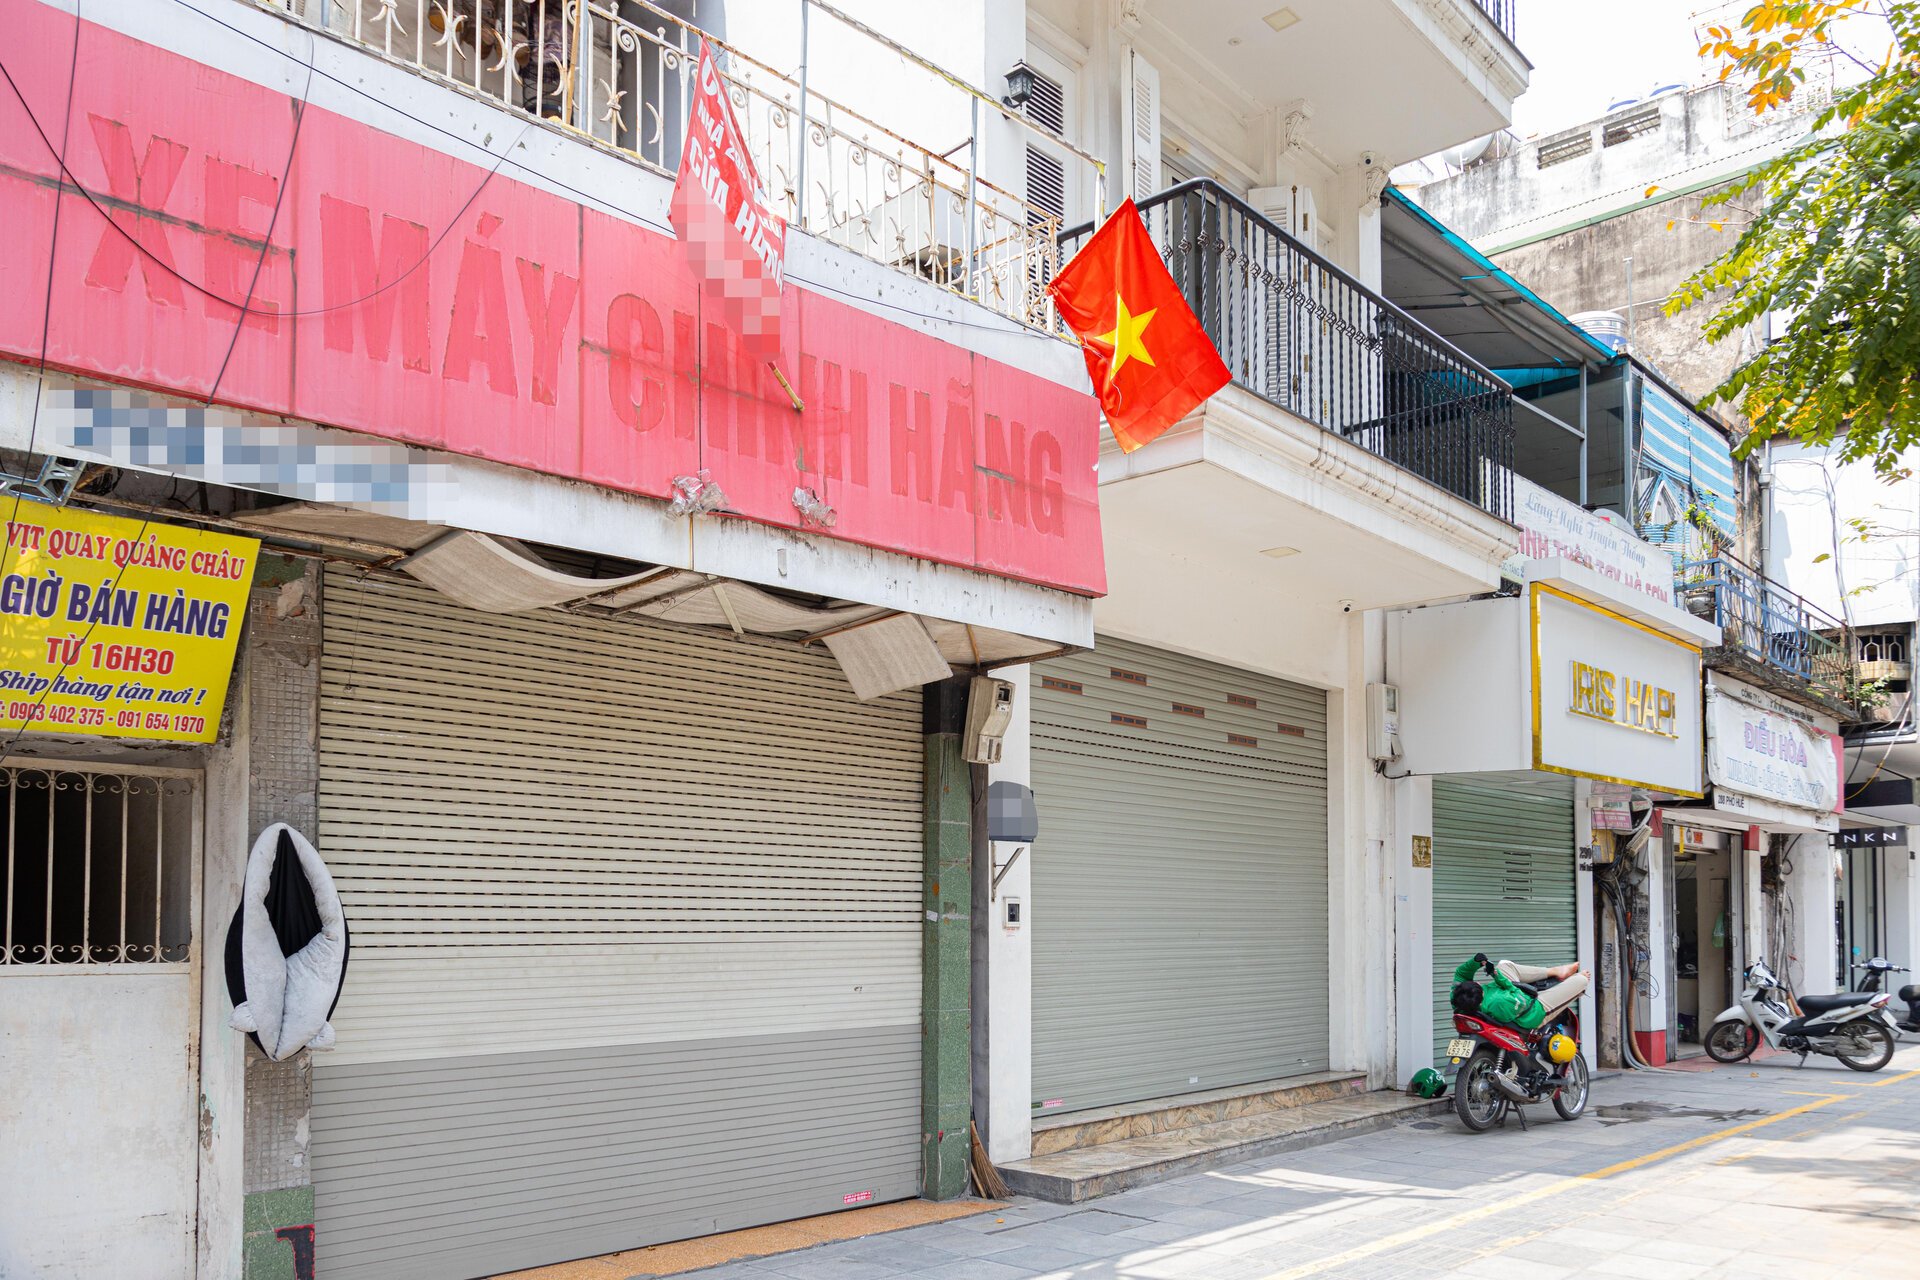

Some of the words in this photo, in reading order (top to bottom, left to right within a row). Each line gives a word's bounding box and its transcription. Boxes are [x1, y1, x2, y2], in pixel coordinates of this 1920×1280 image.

[84, 112, 280, 336] XE
[319, 192, 580, 406] MÁY
[889, 376, 1065, 540] HÃNG
[6, 521, 44, 554] VỊT
[48, 528, 111, 560] QUAY
[113, 534, 186, 572] QUẢNG
[191, 549, 246, 580] CHÂU
[1, 570, 63, 618] GIỜ
[67, 579, 138, 628] BÁN
[143, 589, 230, 639] HÀNG
[46, 634, 85, 666] TỪ
[91, 643, 175, 675] 16H30
[0, 670, 49, 693] Ship
[52, 675, 113, 701] hàng
[117, 683, 154, 705] tận
[157, 687, 192, 704] nơi
[1570, 660, 1616, 718] IRIS
[1623, 675, 1676, 735] HAPI
[9, 702, 45, 721] 0903
[49, 705, 76, 724] 402
[79, 708, 104, 726] 375
[116, 710, 141, 729] 091
[145, 712, 169, 731] 654
[173, 714, 206, 734] 1970
[1744, 717, 1776, 757] ĐIỀU
[1779, 731, 1808, 767] HÒA
[1726, 792, 1735, 807] PHỐ
[1735, 795, 1745, 808] HUẾ
